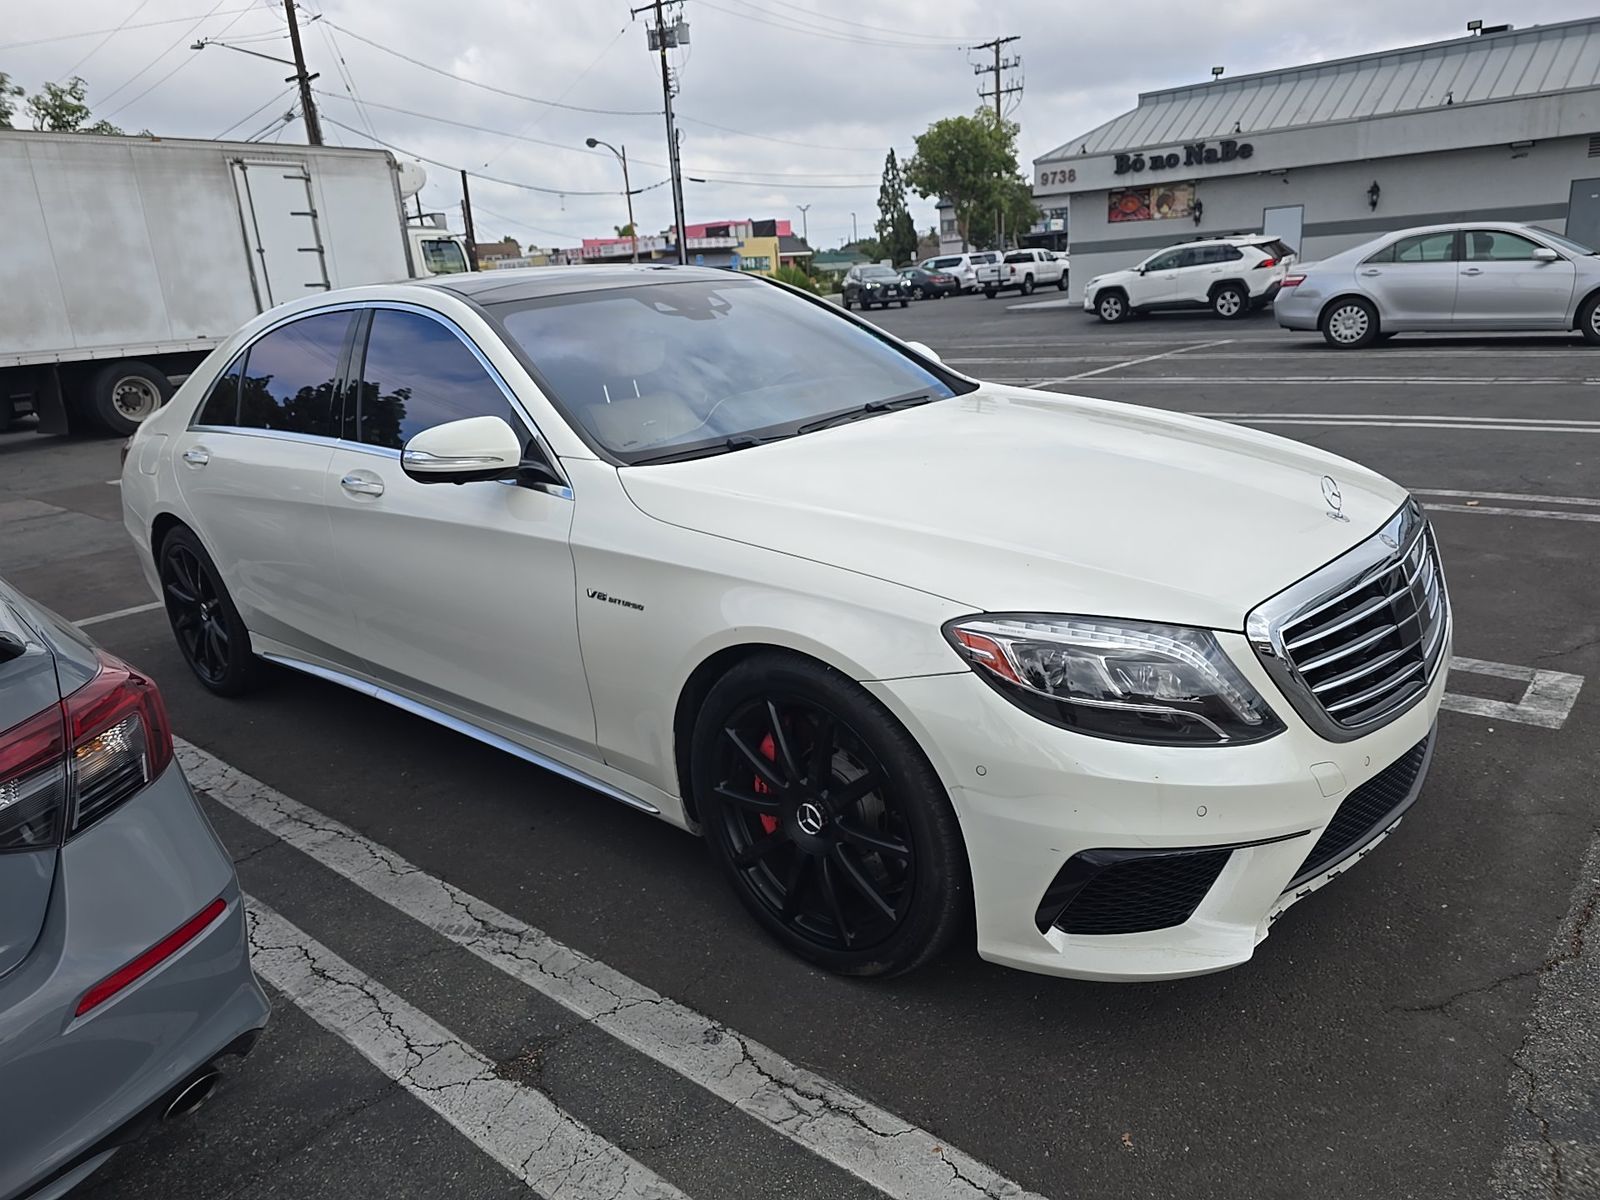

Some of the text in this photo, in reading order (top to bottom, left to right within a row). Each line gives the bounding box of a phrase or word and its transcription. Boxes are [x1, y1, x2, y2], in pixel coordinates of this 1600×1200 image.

[1149, 153, 1180, 171] no
[1183, 140, 1254, 167] NaBe
[1040, 168, 1077, 186] 9738
